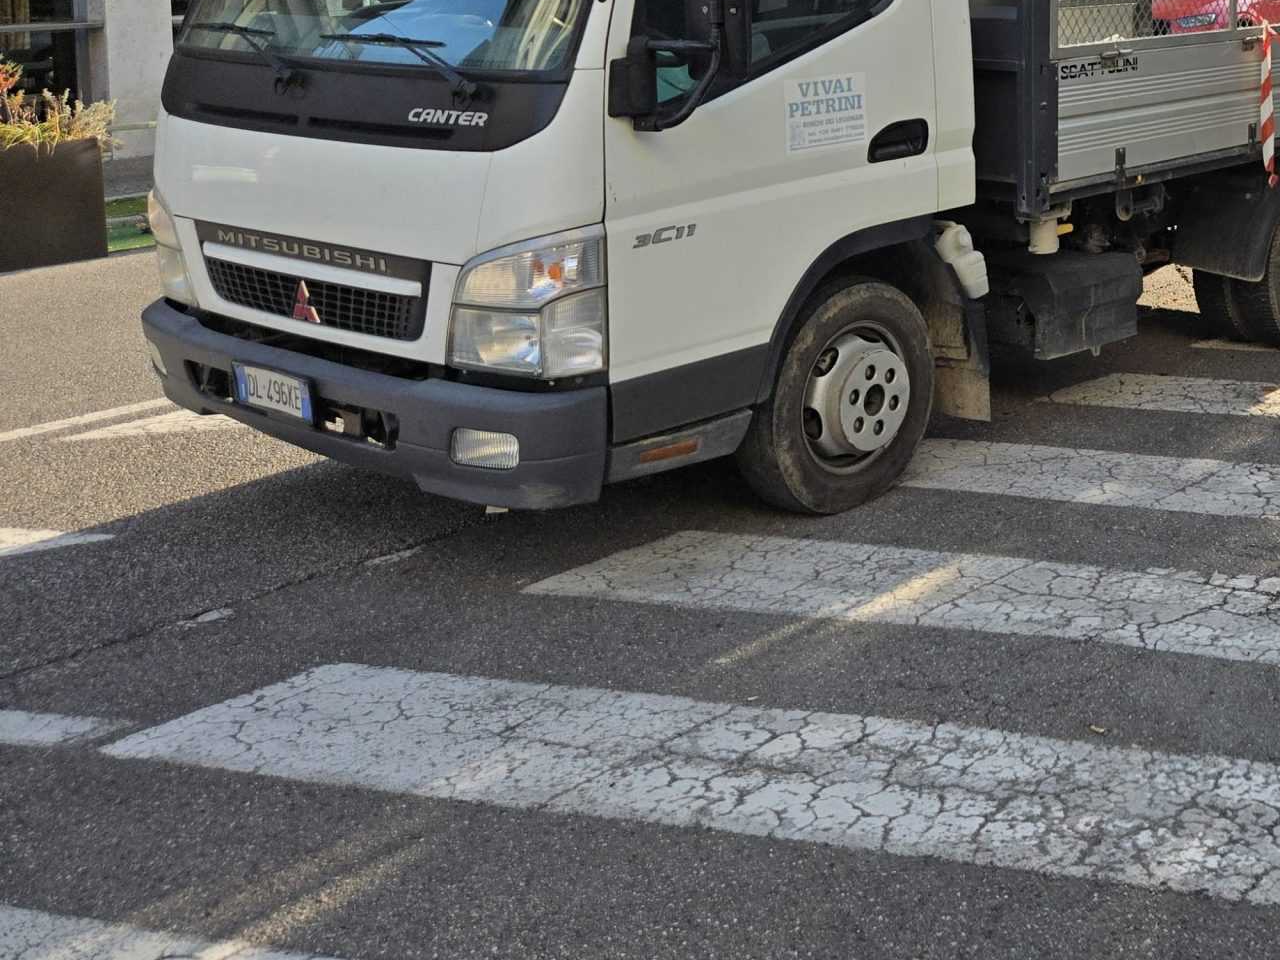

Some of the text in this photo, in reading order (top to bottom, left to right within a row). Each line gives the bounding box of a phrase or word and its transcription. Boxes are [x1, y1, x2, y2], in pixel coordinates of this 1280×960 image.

[798, 77, 853, 97] VIVAI
[407, 107, 489, 127] CANTER
[788, 94, 864, 119] PETRINI
[217, 228, 387, 273] MITSUBISHI
